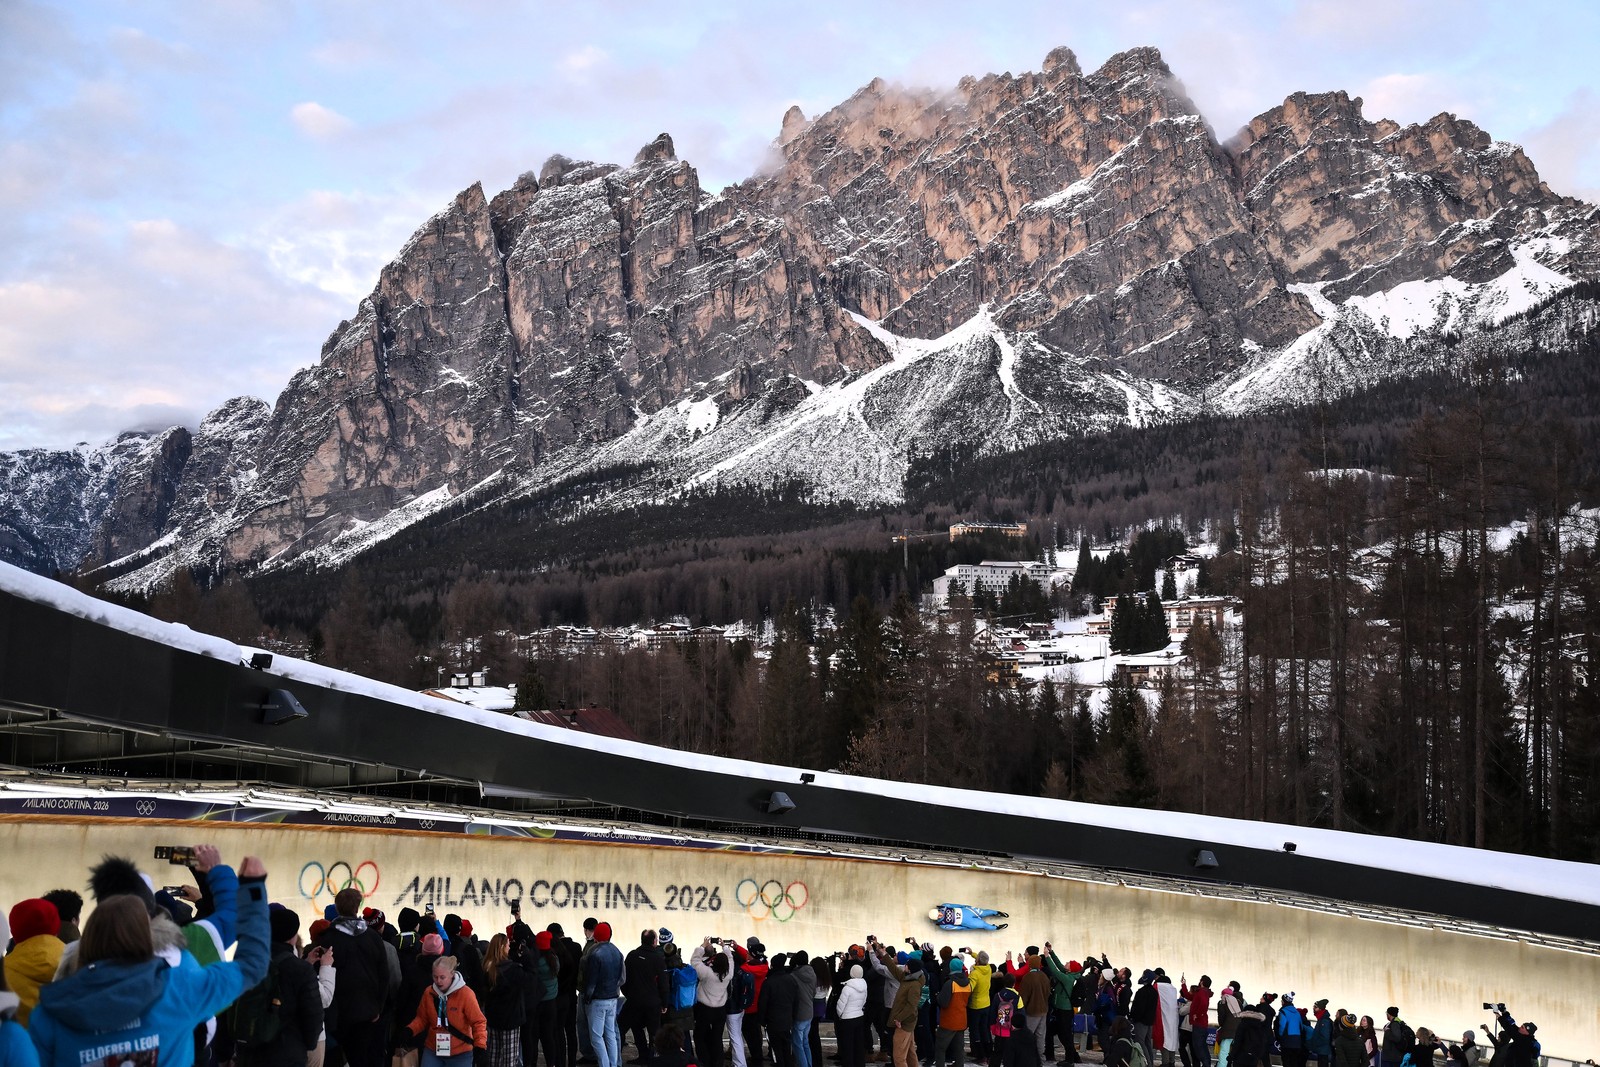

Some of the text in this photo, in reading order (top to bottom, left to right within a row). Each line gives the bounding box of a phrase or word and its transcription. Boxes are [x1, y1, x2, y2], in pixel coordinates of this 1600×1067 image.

[22, 798, 109, 811] MILANO CORTINA 2026
[323, 813, 397, 825] MILANO CORTINA 2026
[393, 876, 722, 912] MILANO CORTINA 2026
[134, 1033, 160, 1052] LEON
